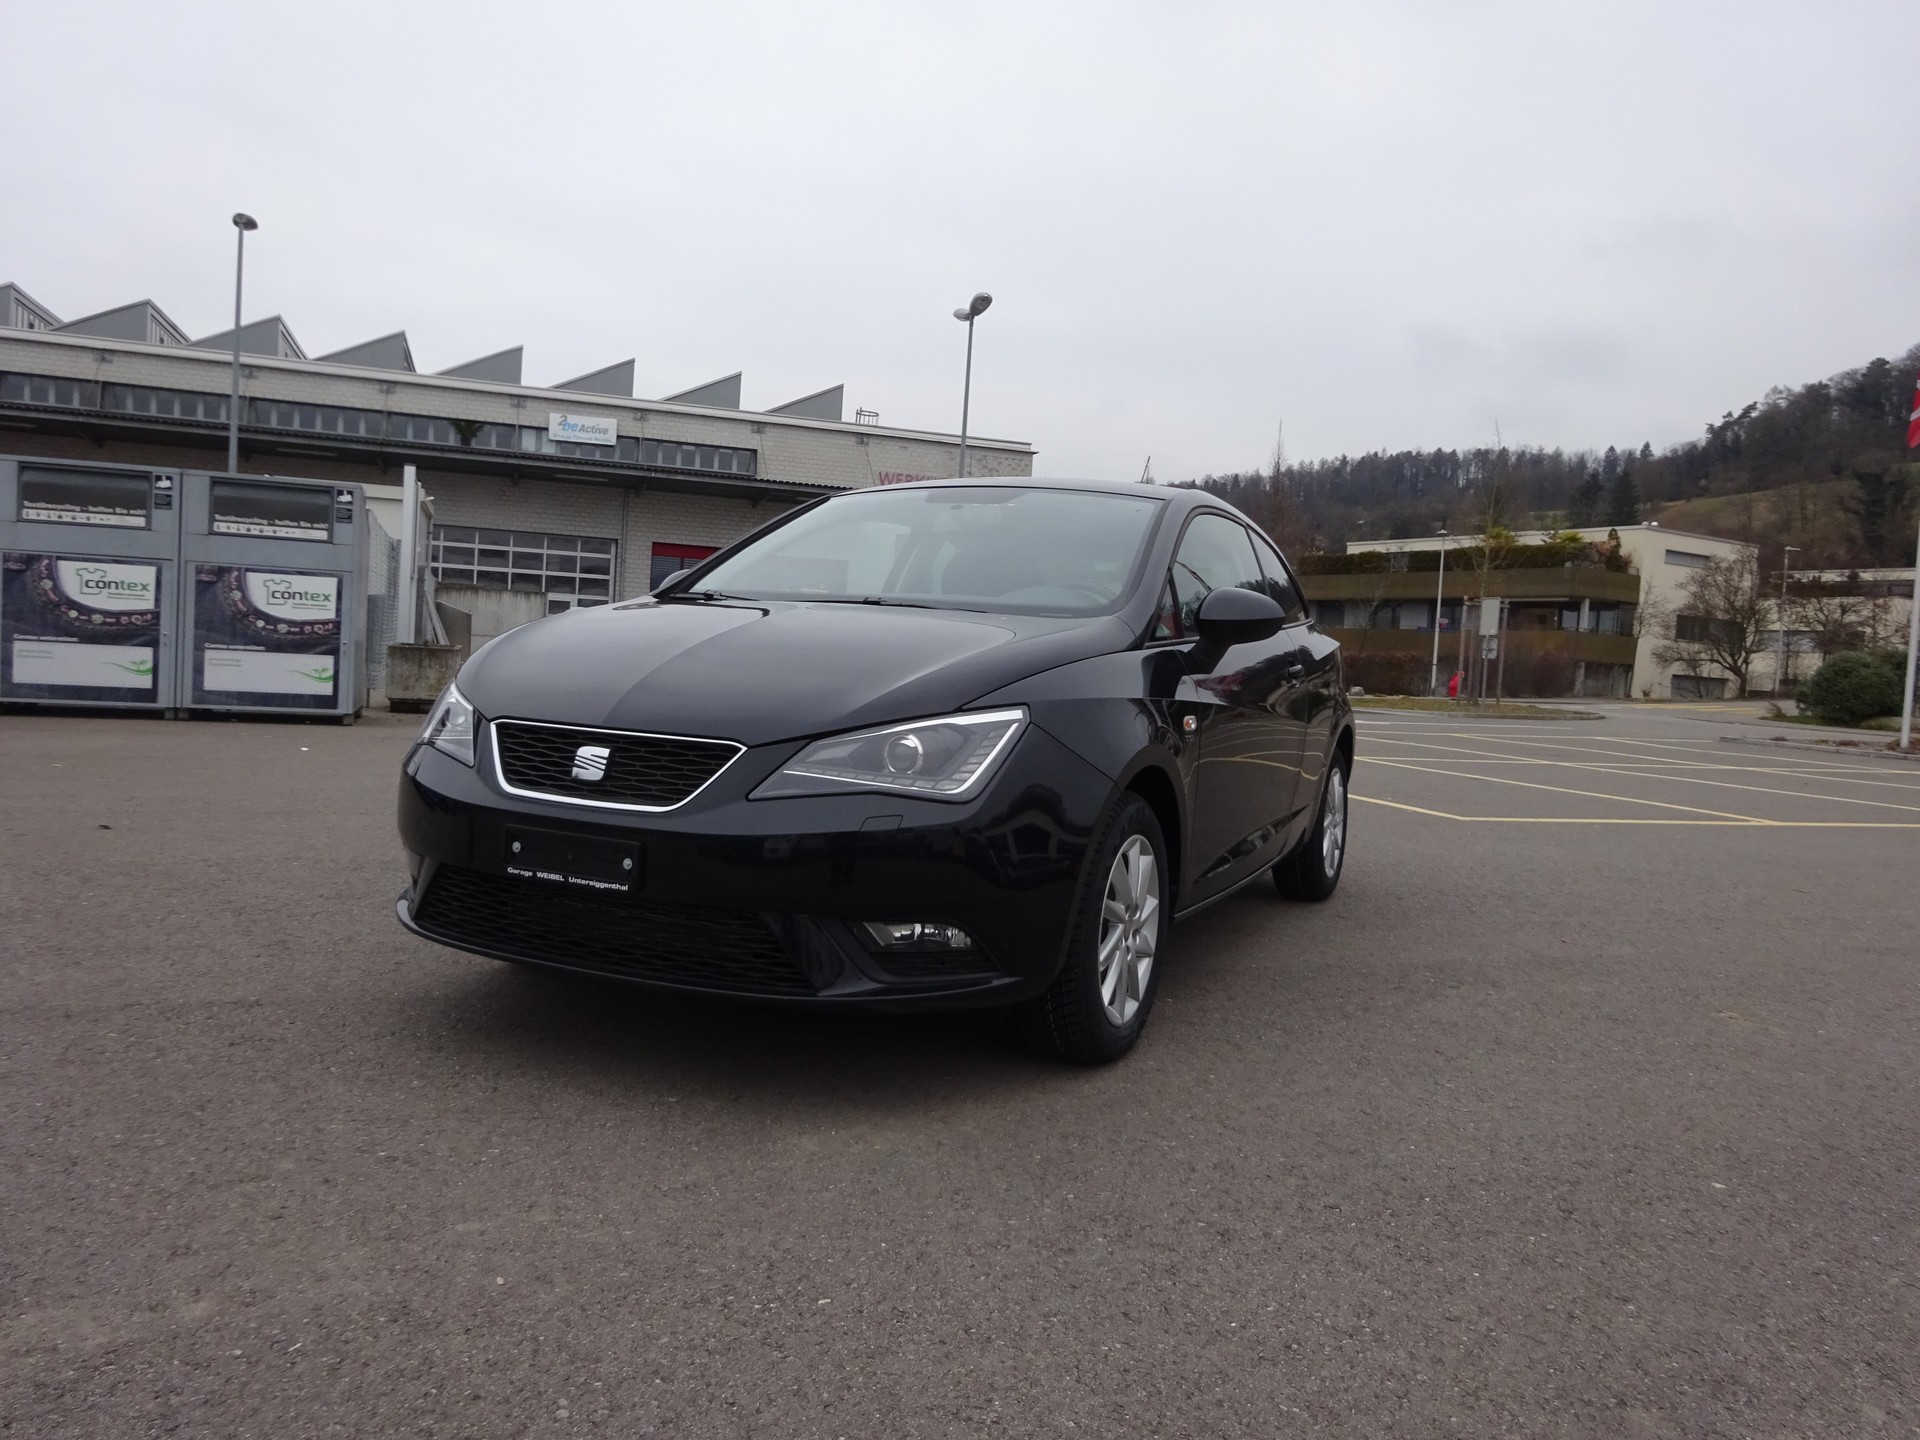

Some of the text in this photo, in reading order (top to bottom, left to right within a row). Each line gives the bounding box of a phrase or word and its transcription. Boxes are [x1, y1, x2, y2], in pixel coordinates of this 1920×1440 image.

[85, 579, 150, 592] contex
[271, 590, 332, 602] contex
[507, 866, 629, 891] Garage WEIBEL Untersiggenthal
